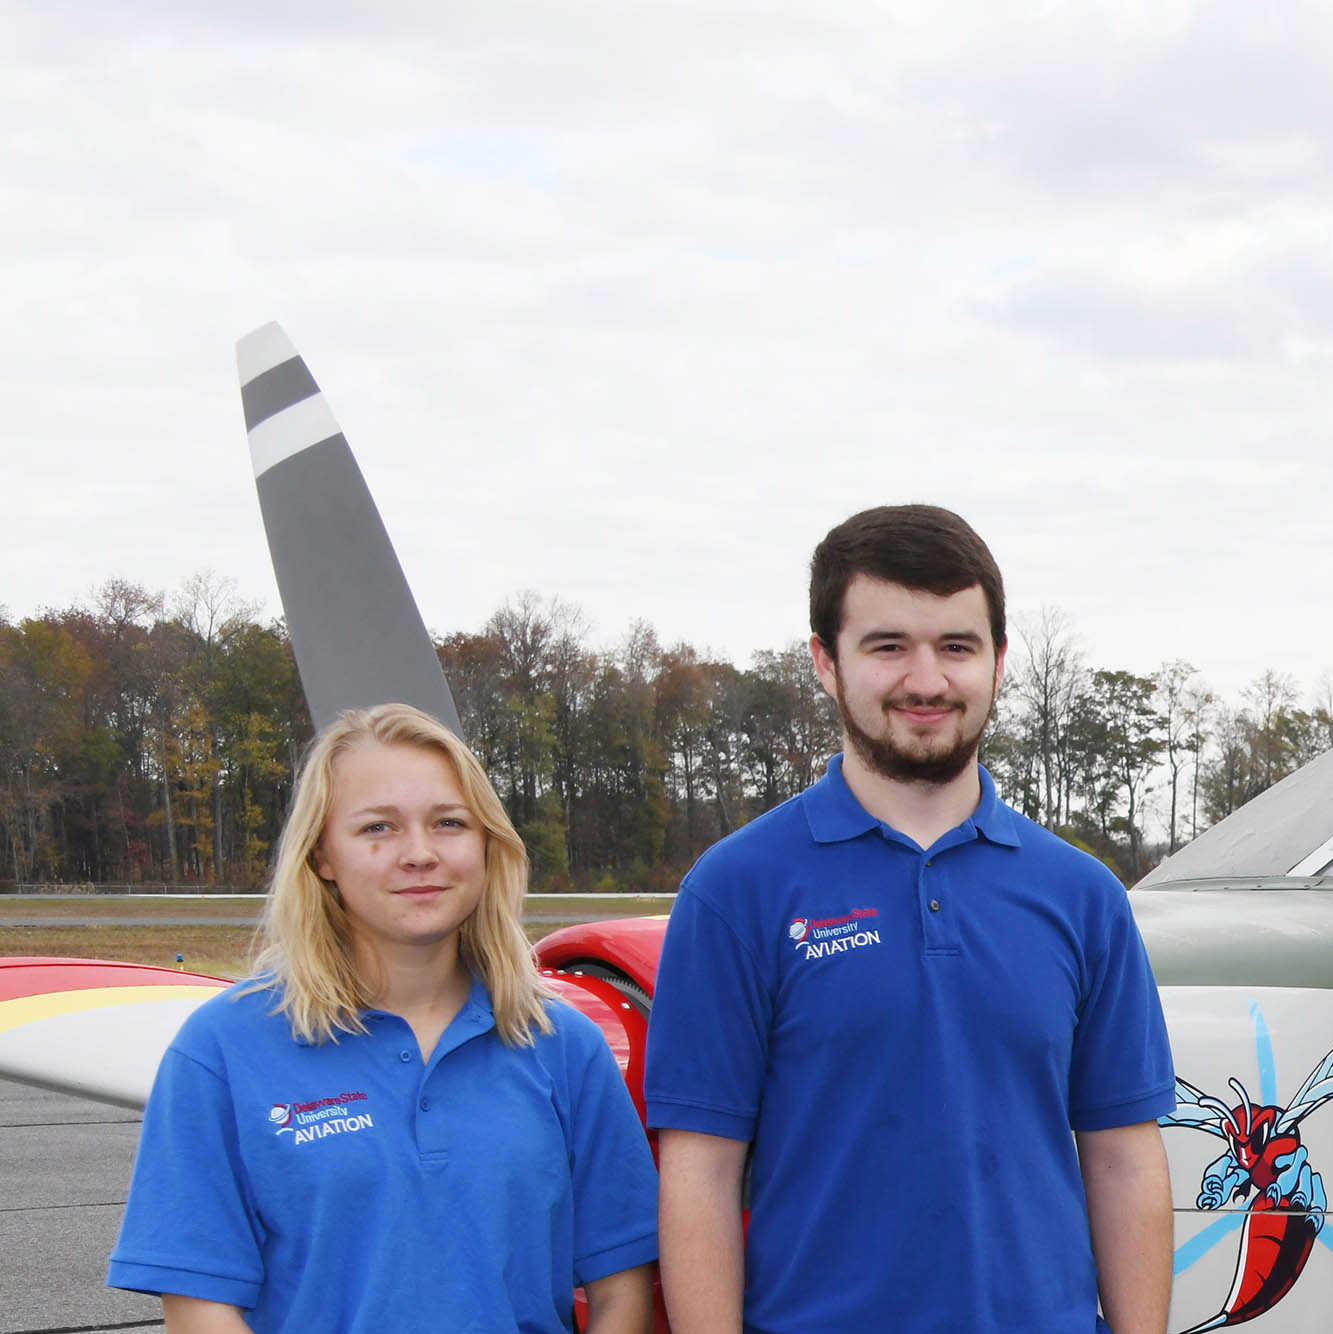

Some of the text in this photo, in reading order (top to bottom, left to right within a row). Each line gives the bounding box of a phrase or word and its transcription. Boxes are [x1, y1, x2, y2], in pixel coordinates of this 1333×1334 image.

[813, 920, 859, 939] University
[806, 930, 881, 960] AVIATION
[296, 1104, 348, 1125] University
[295, 1113, 374, 1145] AVIATION
